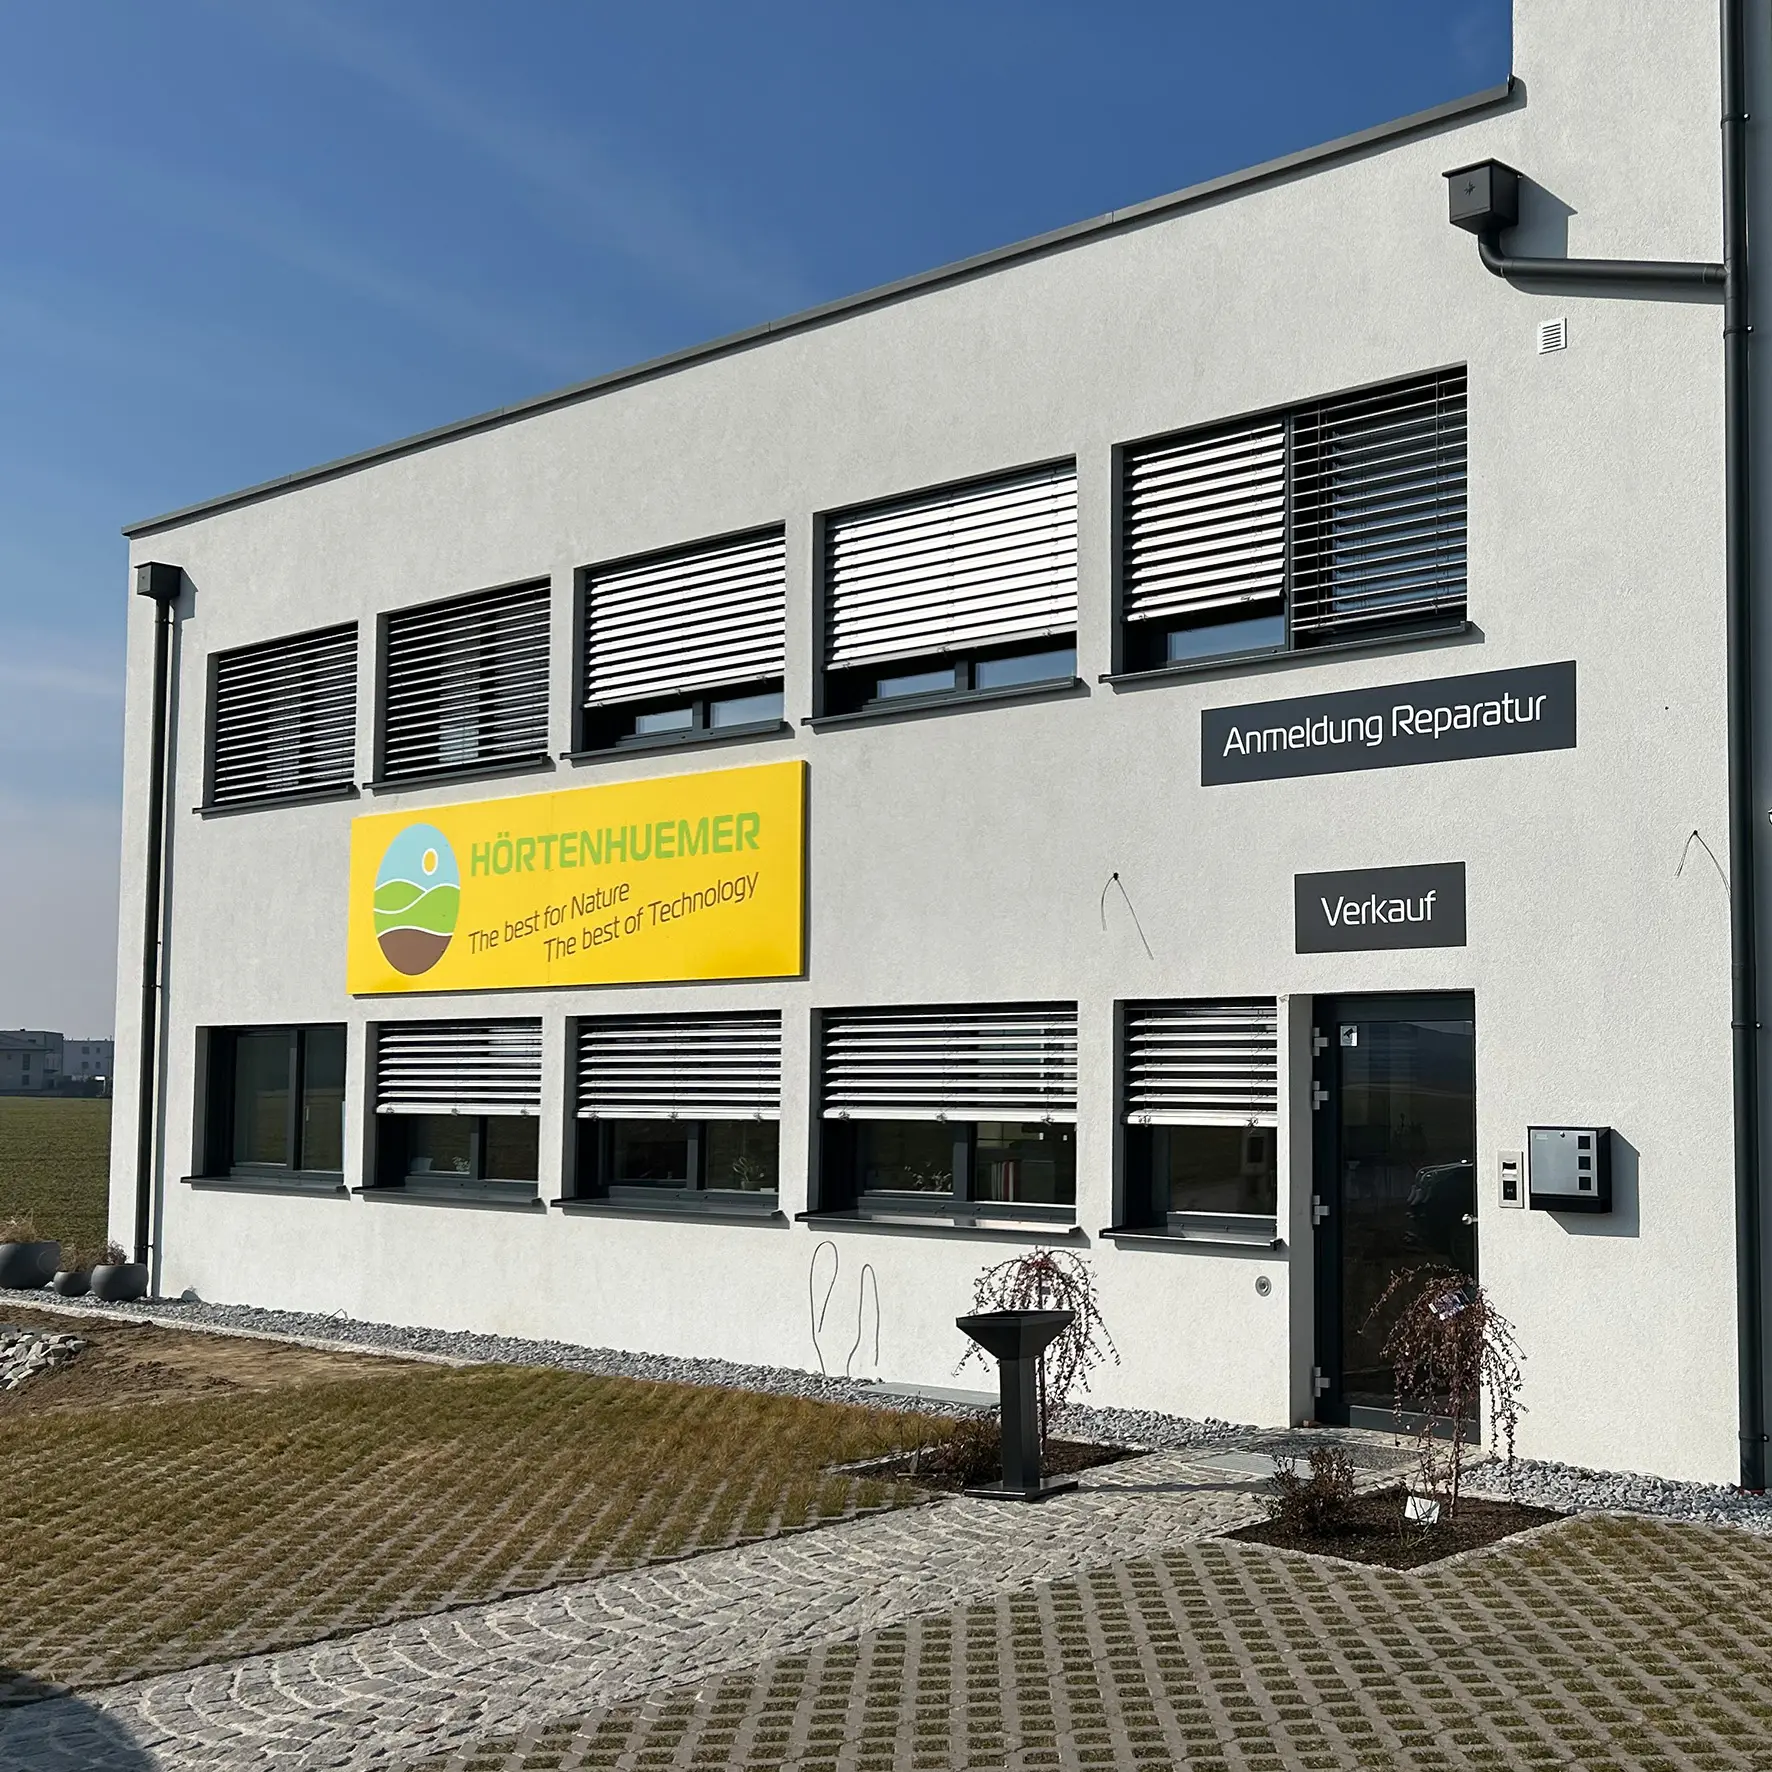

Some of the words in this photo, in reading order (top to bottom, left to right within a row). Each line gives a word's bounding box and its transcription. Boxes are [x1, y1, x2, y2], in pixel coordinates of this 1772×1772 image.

[1222, 714, 1383, 757] Anmeldung
[1391, 692, 1547, 740] Reparatur
[470, 811, 761, 877] HÖRTENHUEMER
[469, 931, 499, 955] The
[504, 911, 541, 942] best
[543, 904, 568, 929] for
[571, 881, 630, 918] Nature
[543, 937, 577, 963] The
[582, 918, 620, 950] best
[624, 908, 644, 935] of
[648, 871, 760, 926] Technology
[1320, 889, 1437, 927] Verkauf
